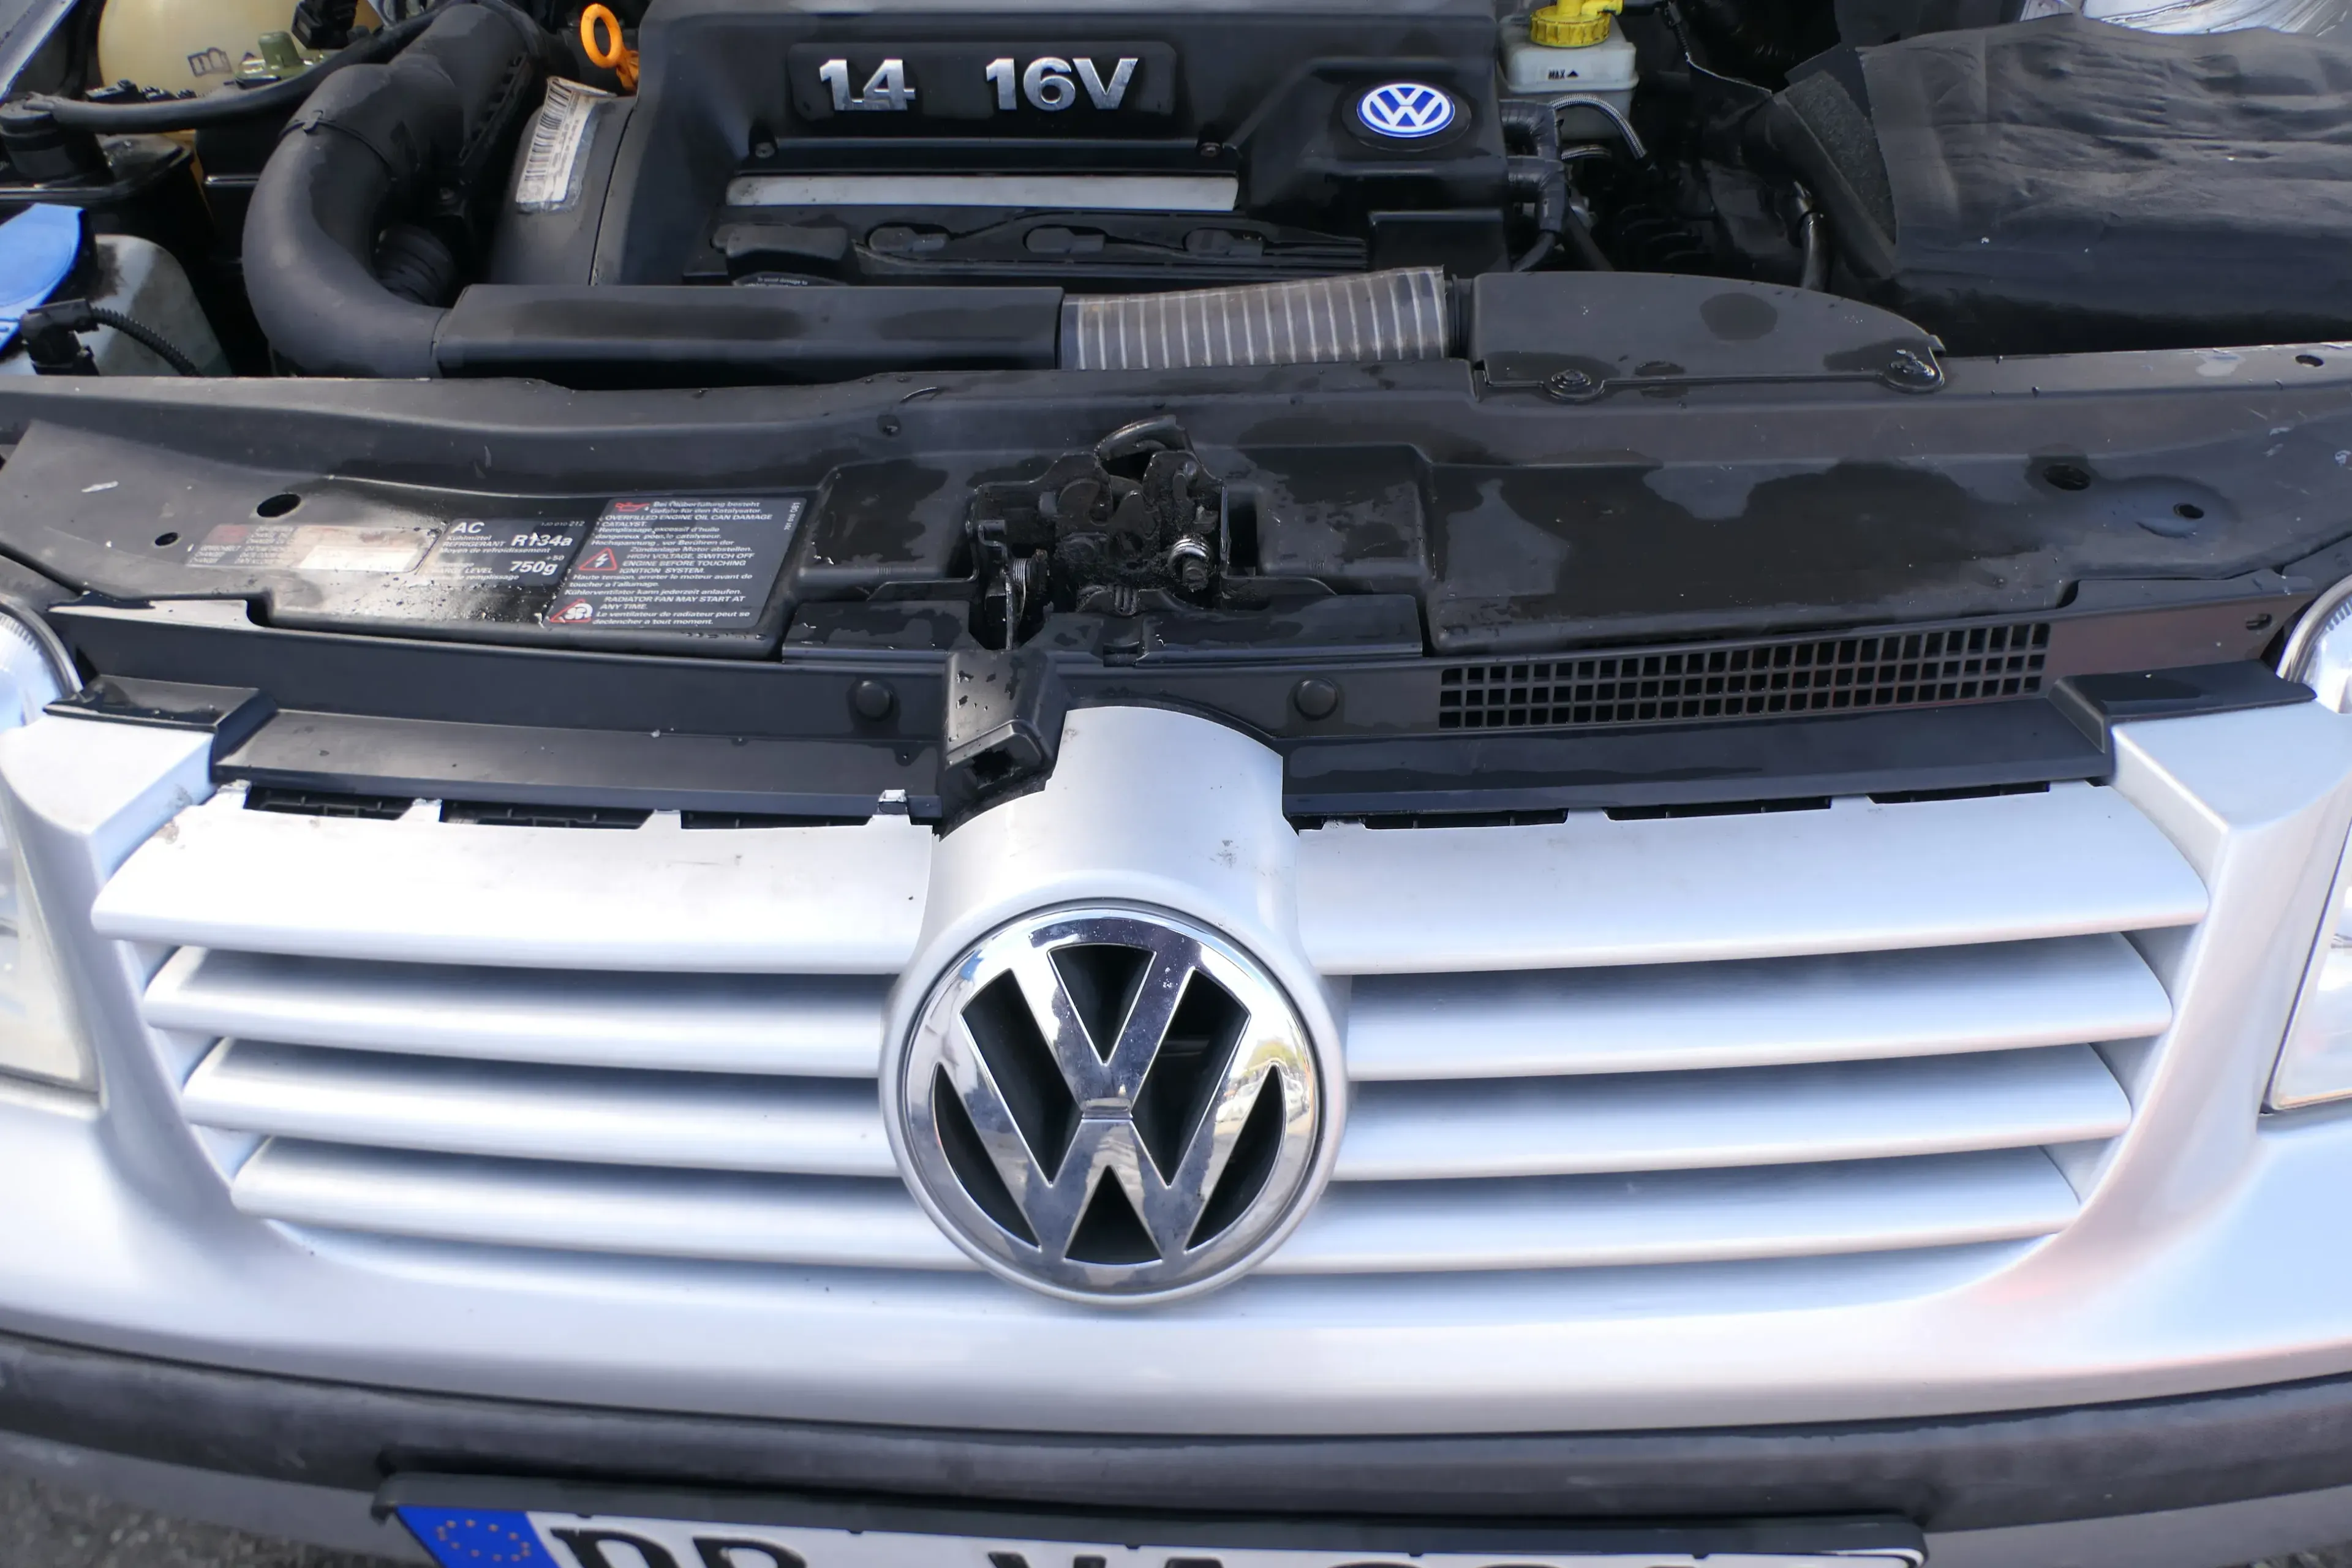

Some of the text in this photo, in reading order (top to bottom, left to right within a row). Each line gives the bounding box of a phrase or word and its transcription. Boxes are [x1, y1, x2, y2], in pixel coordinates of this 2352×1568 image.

[1548, 69, 1566, 80] MAX
[985, 56, 1138, 111] 16V
[1361, 83, 1452, 135] VW
[451, 521, 484, 533] AC
[511, 533, 573, 546] R134a
[509, 560, 558, 575] 750g
[907, 910, 1316, 1295] VW
